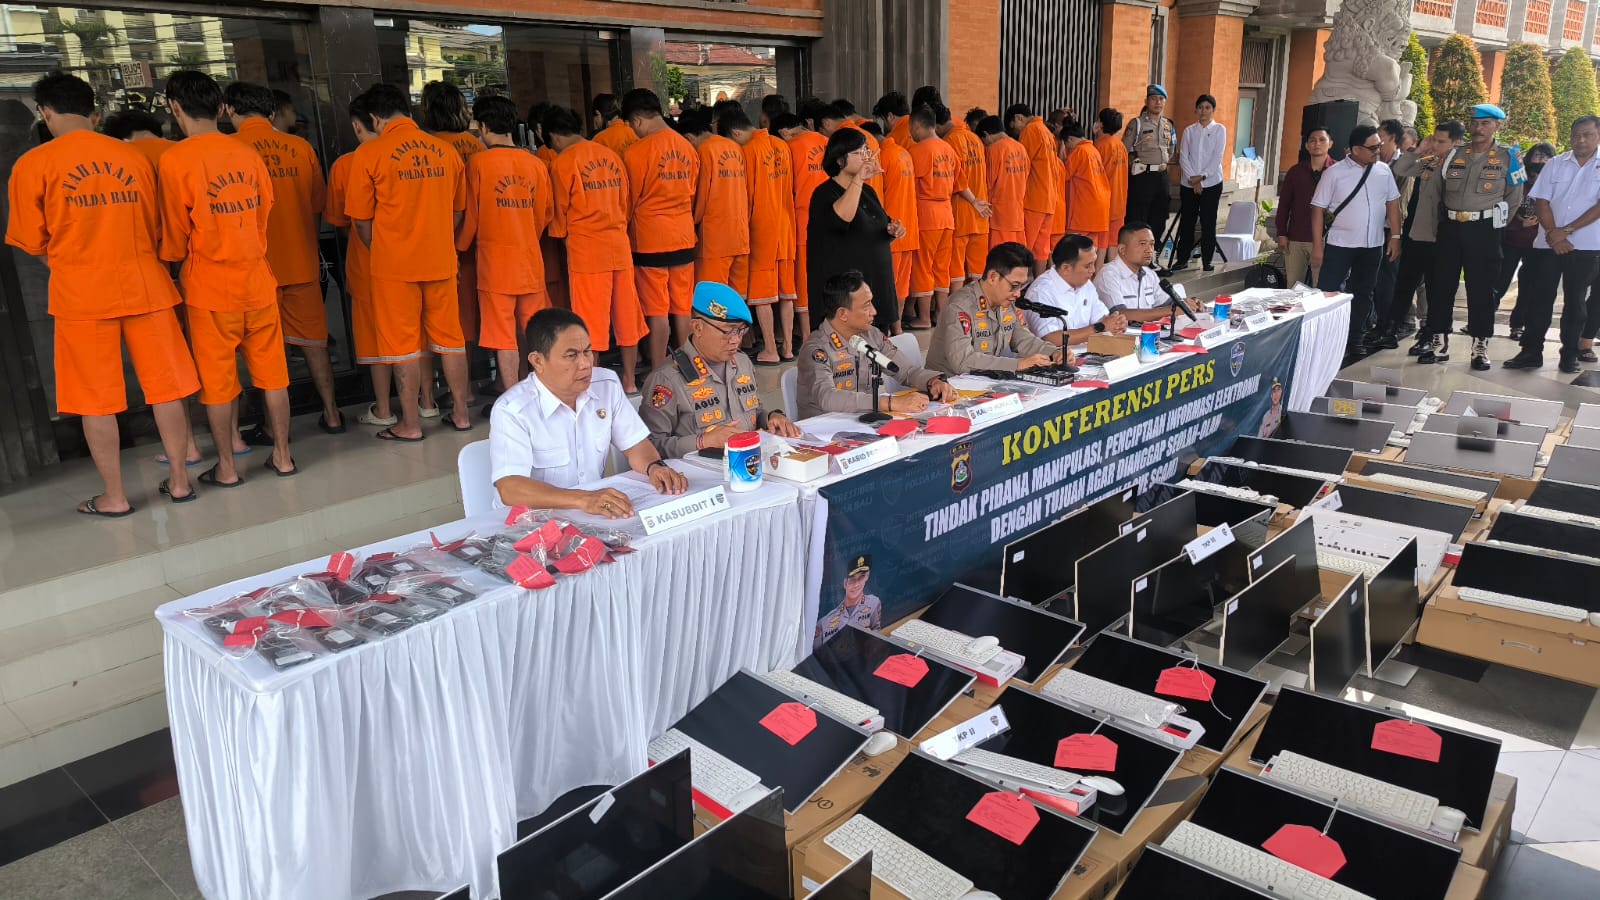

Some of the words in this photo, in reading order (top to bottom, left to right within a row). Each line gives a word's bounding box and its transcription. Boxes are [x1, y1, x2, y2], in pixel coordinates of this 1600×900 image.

[253, 139, 297, 158] HANAN
[391, 139, 445, 162] TAHANAN
[411, 154, 430, 167] 34
[63, 160, 135, 191] TAHANAN
[398, 169, 424, 180] POLDA
[426, 166, 445, 178] BALI
[65, 193, 107, 207] POLDA
[111, 190, 138, 204] BALI
[209, 201, 244, 214] POLDA
[694, 396, 720, 411] AGUS
[1001, 378, 1163, 466] KONFERENSI
[1164, 358, 1217, 400] PERS
[924, 493, 979, 542] TINDAK
[980, 472, 1030, 516] PIDANA
[1032, 440, 1102, 493] MANIPULASI,
[1105, 413, 1167, 459] PENCIPTAAN
[1166, 393, 1214, 432] INFORMASI
[1214, 373, 1262, 410] ELEKTRONIK
[991, 497, 1042, 544] DENGAN
[1045, 475, 1086, 518] TUJUAN
[1086, 462, 1116, 496] AGAR
[1116, 440, 1167, 481] DIANGGAP
[1166, 412, 1223, 457] SEOLAH-OLAH
[656, 500, 708, 525] KASUBDIT
[710, 497, 716, 506] I
